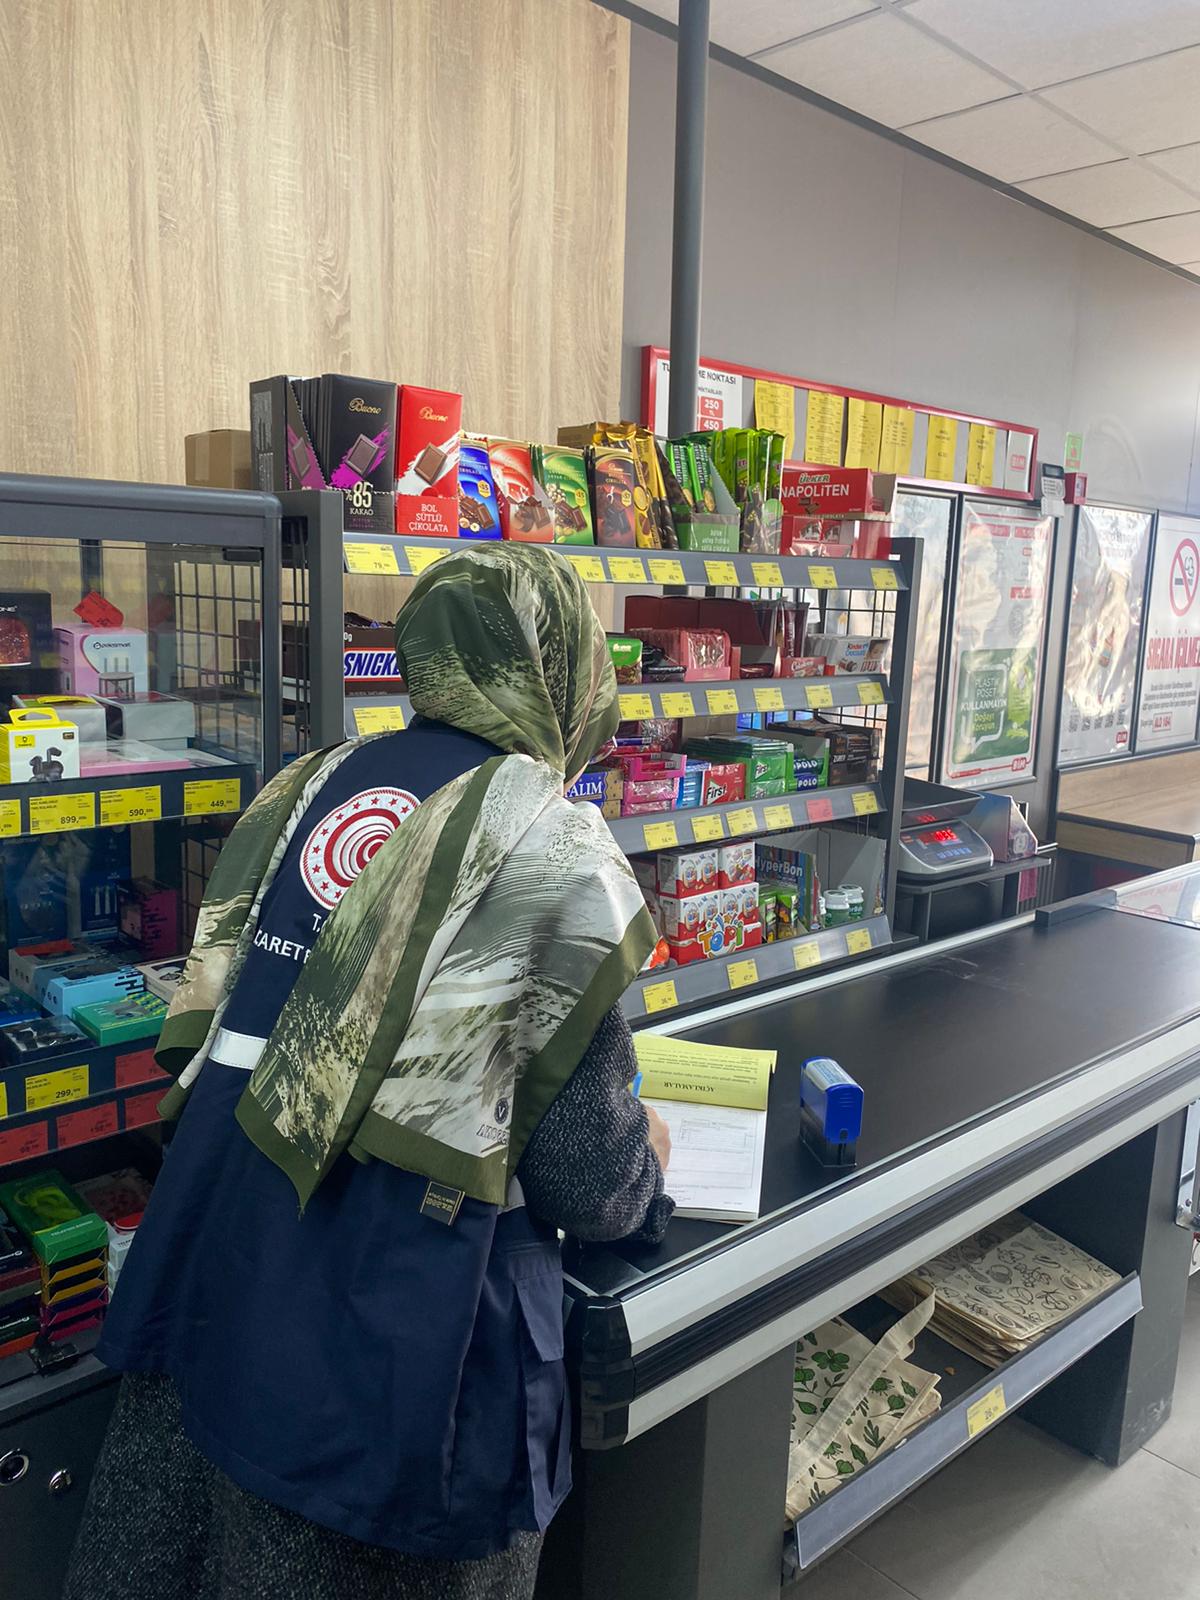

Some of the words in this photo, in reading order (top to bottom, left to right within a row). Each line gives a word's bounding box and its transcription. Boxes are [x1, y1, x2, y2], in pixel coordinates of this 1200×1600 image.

[707, 372, 736, 384] NOKTASI
[704, 399, 719, 410] 250
[703, 420, 719, 430] 450
[345, 481, 374, 508] %85
[350, 508, 374, 516] KAKAO
[421, 503, 438, 513] BOL
[416, 512, 442, 523] SÜTLÜ
[408, 521, 448, 533] ÇİKOLATA
[1147, 629, 1173, 670] SİGARA
[1174, 629, 1200, 673] İÇİLME
[798, 777, 818, 787] POLO
[565, 781, 603, 798] ALIM
[706, 784, 727, 799] First
[663, 1081, 715, 1093] AÇIKLAMALAR
